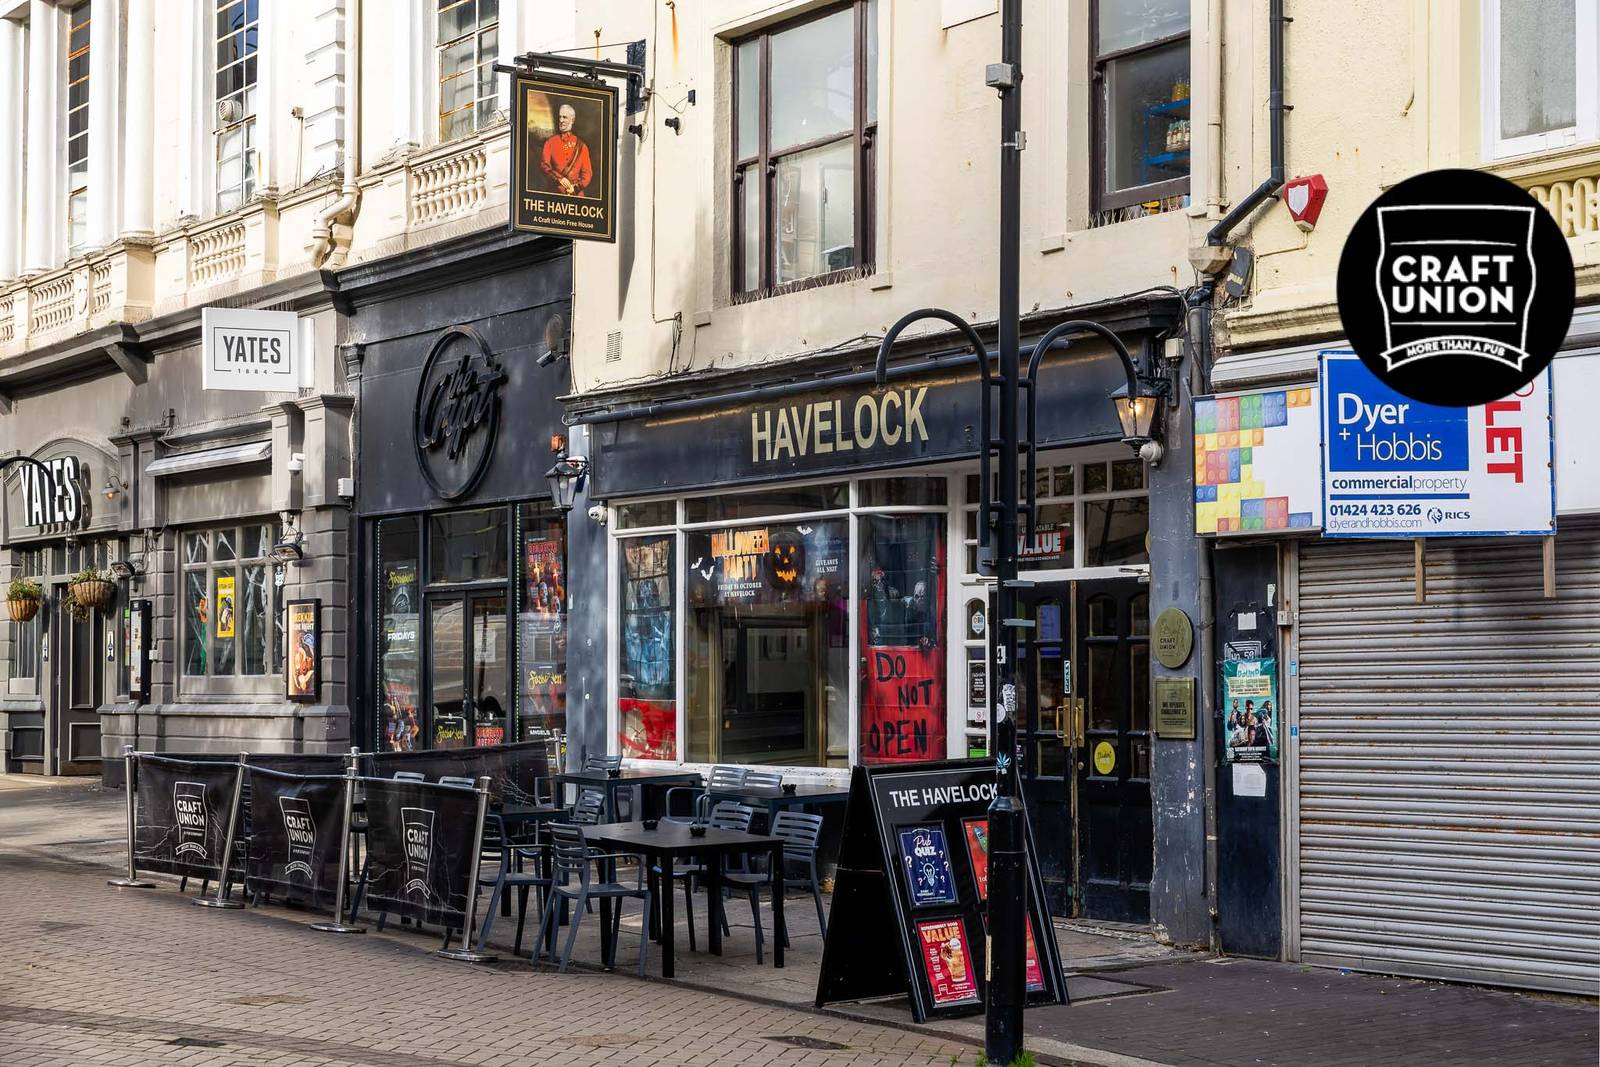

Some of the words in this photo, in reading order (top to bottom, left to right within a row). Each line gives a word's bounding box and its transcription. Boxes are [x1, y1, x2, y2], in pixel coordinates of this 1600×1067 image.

[523, 198, 545, 212] THE
[547, 201, 604, 219] HAVELOCK
[538, 216, 551, 224] Craft
[551, 218, 566, 226] Union
[578, 221, 594, 229] House
[223, 335, 282, 364] YATES
[1337, 392, 1410, 432] Dyer
[751, 387, 929, 463] HAVELOCK
[1356, 431, 1443, 461] Hobbis
[1485, 400, 1524, 484] LET
[19, 456, 80, 527] YATES
[1330, 504, 1368, 516] 01424
[1370, 504, 1394, 516] 423
[1397, 504, 1421, 516] 626
[1445, 511, 1471, 520] RICS
[1329, 518, 1423, 531] dyerandhobbis.com
[711, 528, 770, 560] HALLOWEEN
[723, 555, 757, 581] PARTY
[387, 631, 416, 641] FRIDAYS
[876, 652, 906, 682] DO
[898, 679, 934, 712] NOT
[869, 718, 928, 757] OPEN
[889, 789, 920, 808] THE
[922, 783, 998, 805] HAVELOCK
[177, 800, 202, 814] CRAFT
[178, 812, 205, 826] UNION
[286, 815, 310, 830] CRAFT
[288, 828, 314, 844] UNION
[407, 828, 429, 845] CRAFT
[913, 834, 932, 850] Pub
[407, 843, 428, 860] UNION
[914, 846, 937, 857] QUIZ
[922, 926, 962, 944] VALUE
